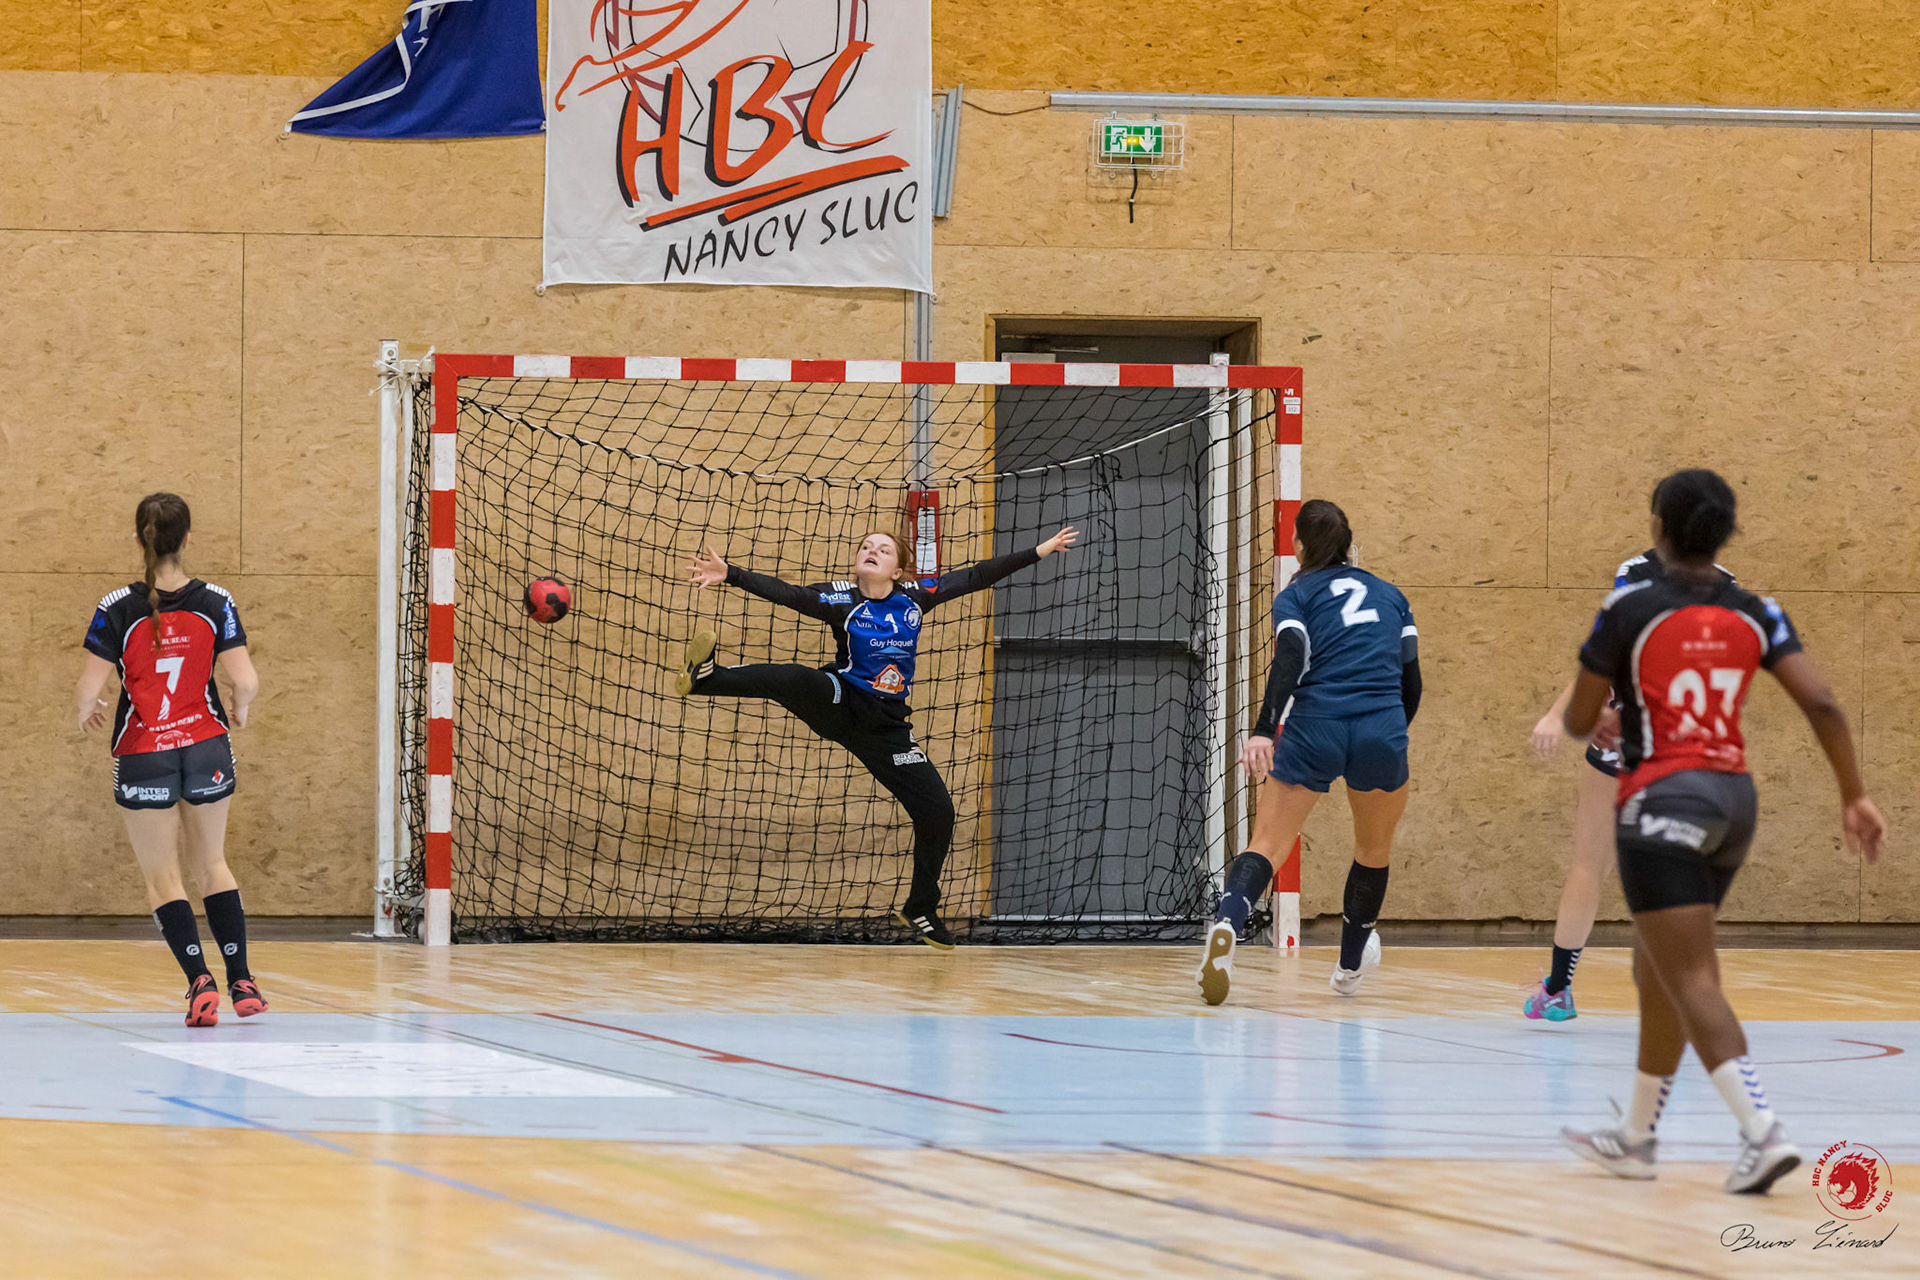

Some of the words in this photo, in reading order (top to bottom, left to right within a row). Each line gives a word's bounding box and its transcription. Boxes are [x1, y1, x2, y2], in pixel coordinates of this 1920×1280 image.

[616, 41, 897, 208] HBC
[664, 208, 806, 282] NANCY
[820, 181, 919, 246] SLUC
[1330, 577, 1381, 627] 2
[869, 638, 886, 649] Guy
[886, 638, 914, 648] Hoquet
[155, 656, 186, 720] 7
